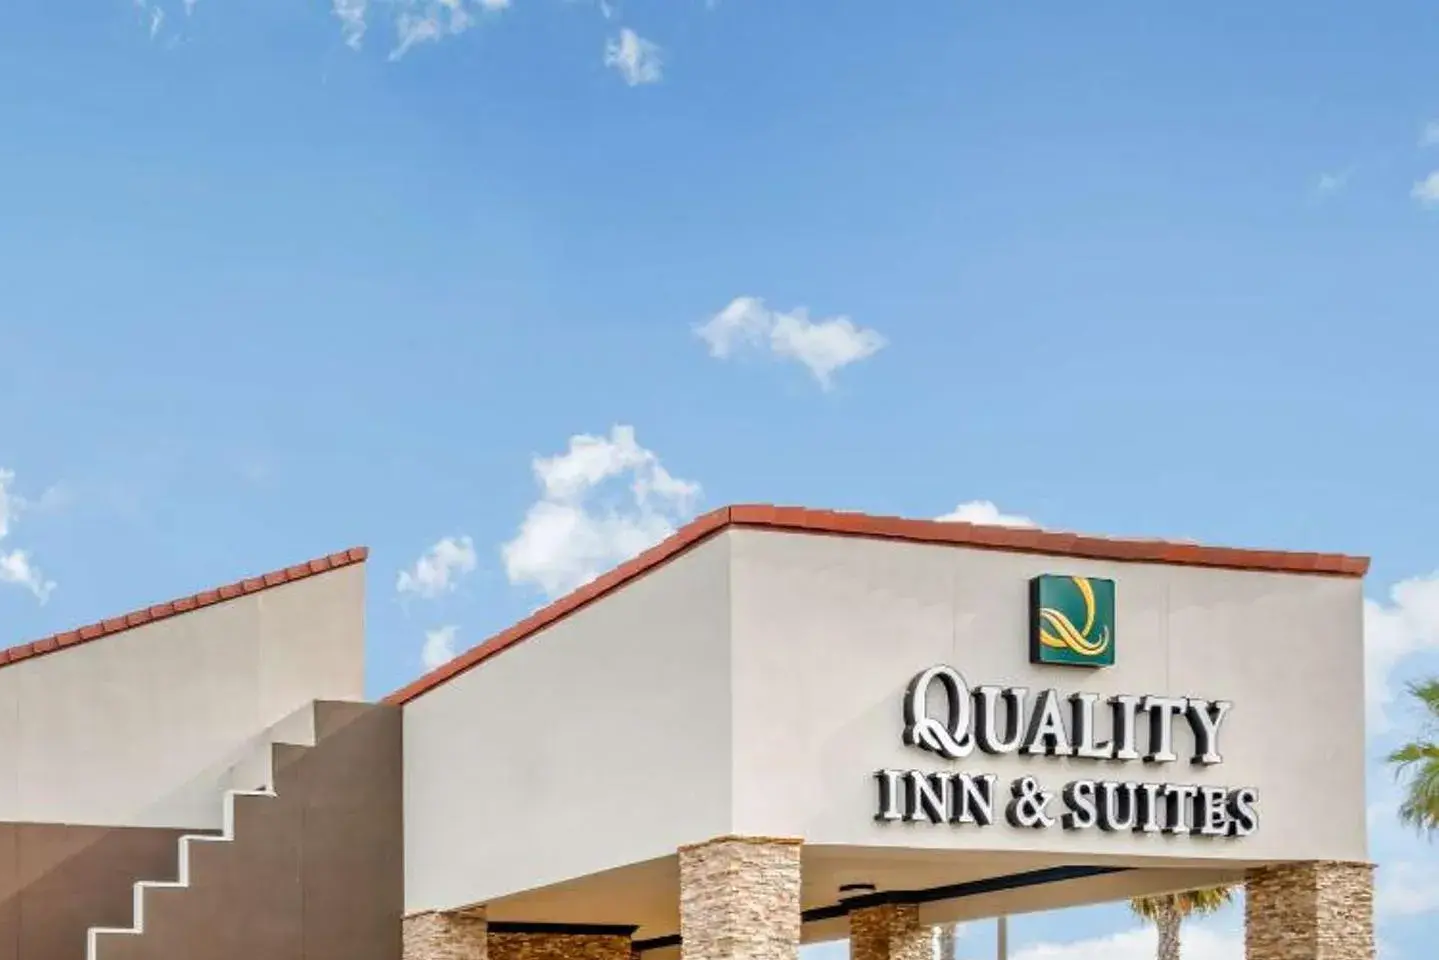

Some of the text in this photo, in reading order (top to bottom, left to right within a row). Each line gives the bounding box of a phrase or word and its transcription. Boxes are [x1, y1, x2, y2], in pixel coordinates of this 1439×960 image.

[903, 664, 1232, 765] QUALITY
[875, 769, 1260, 837] INN & SUITES
